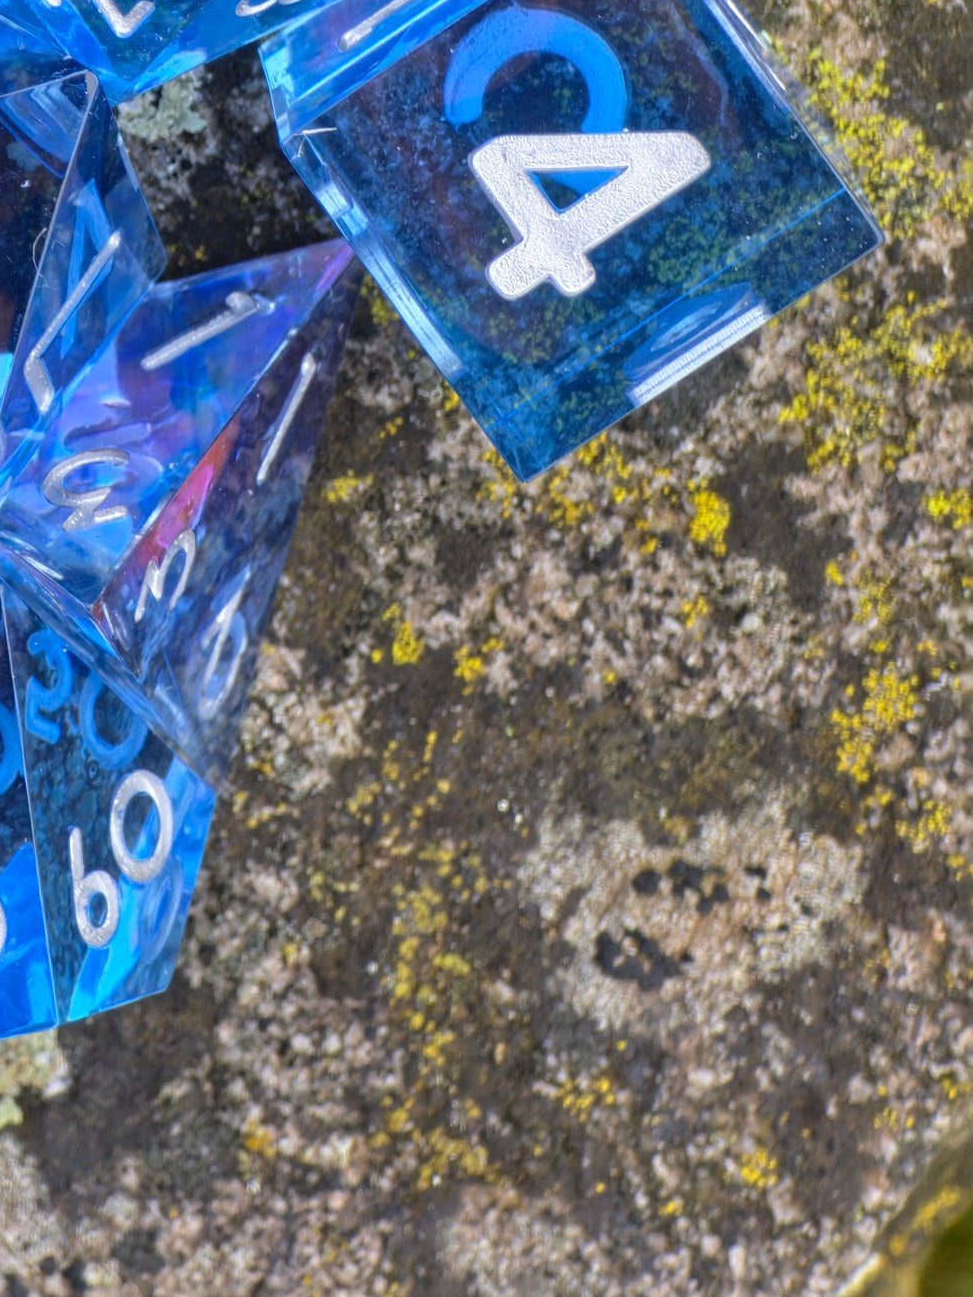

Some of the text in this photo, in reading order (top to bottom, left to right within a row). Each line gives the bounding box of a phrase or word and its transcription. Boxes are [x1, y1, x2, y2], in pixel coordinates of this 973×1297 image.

[466, 130, 713, 299] 4
[24, 230, 122, 415] 7
[68, 768, 175, 950] 60
